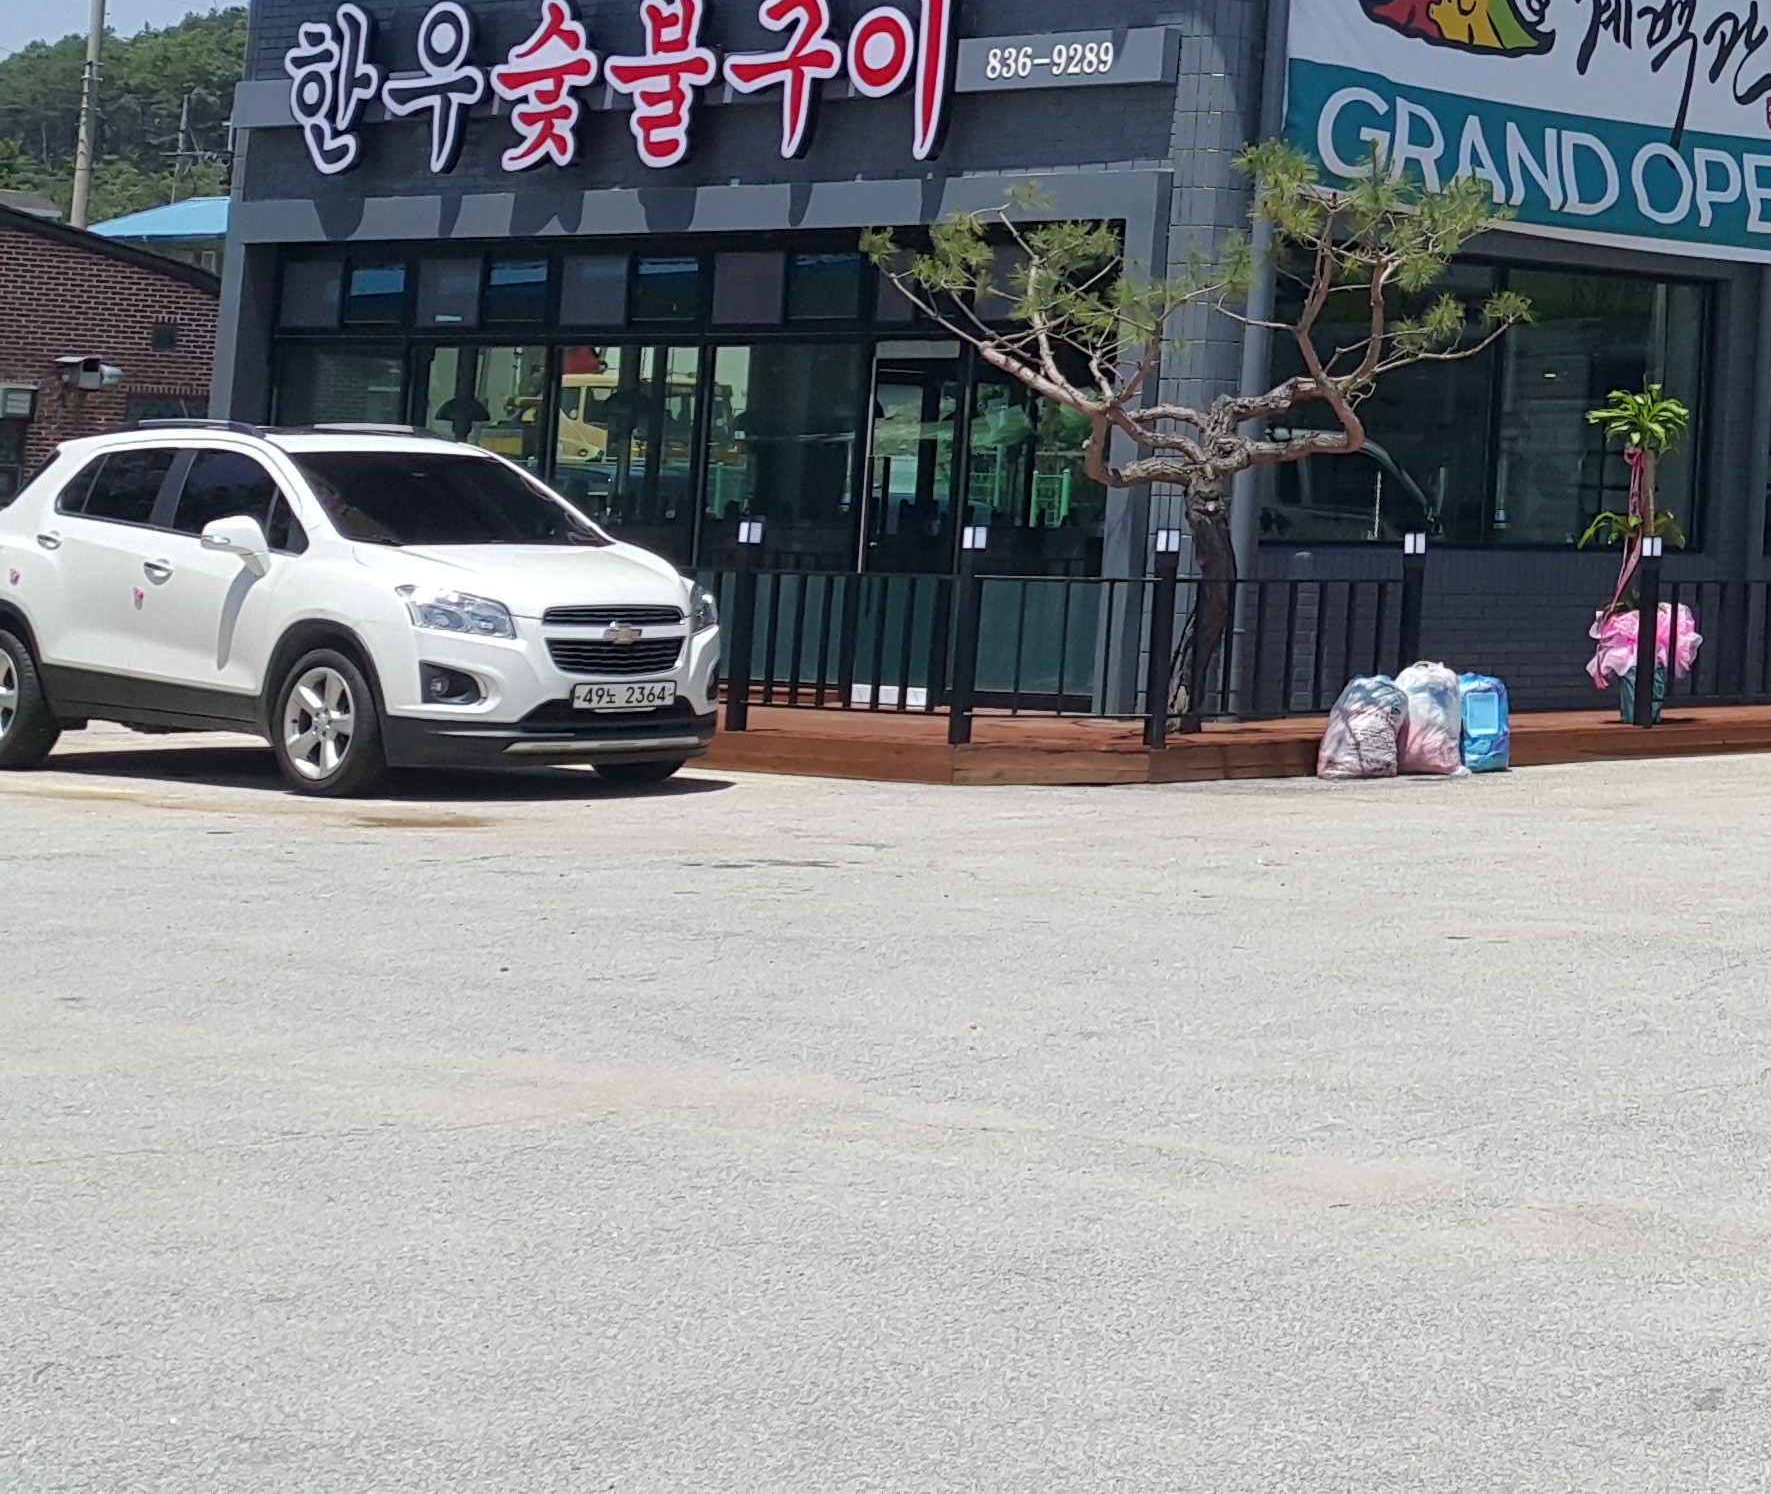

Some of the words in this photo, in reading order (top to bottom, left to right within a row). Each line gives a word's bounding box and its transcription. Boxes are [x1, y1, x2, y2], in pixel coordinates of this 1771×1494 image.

[986, 41, 1114, 79] 836-9289
[1316, 86, 1620, 216] GRAND
[583, 687, 616, 705] 49노
[625, 686, 666, 705] 2364
